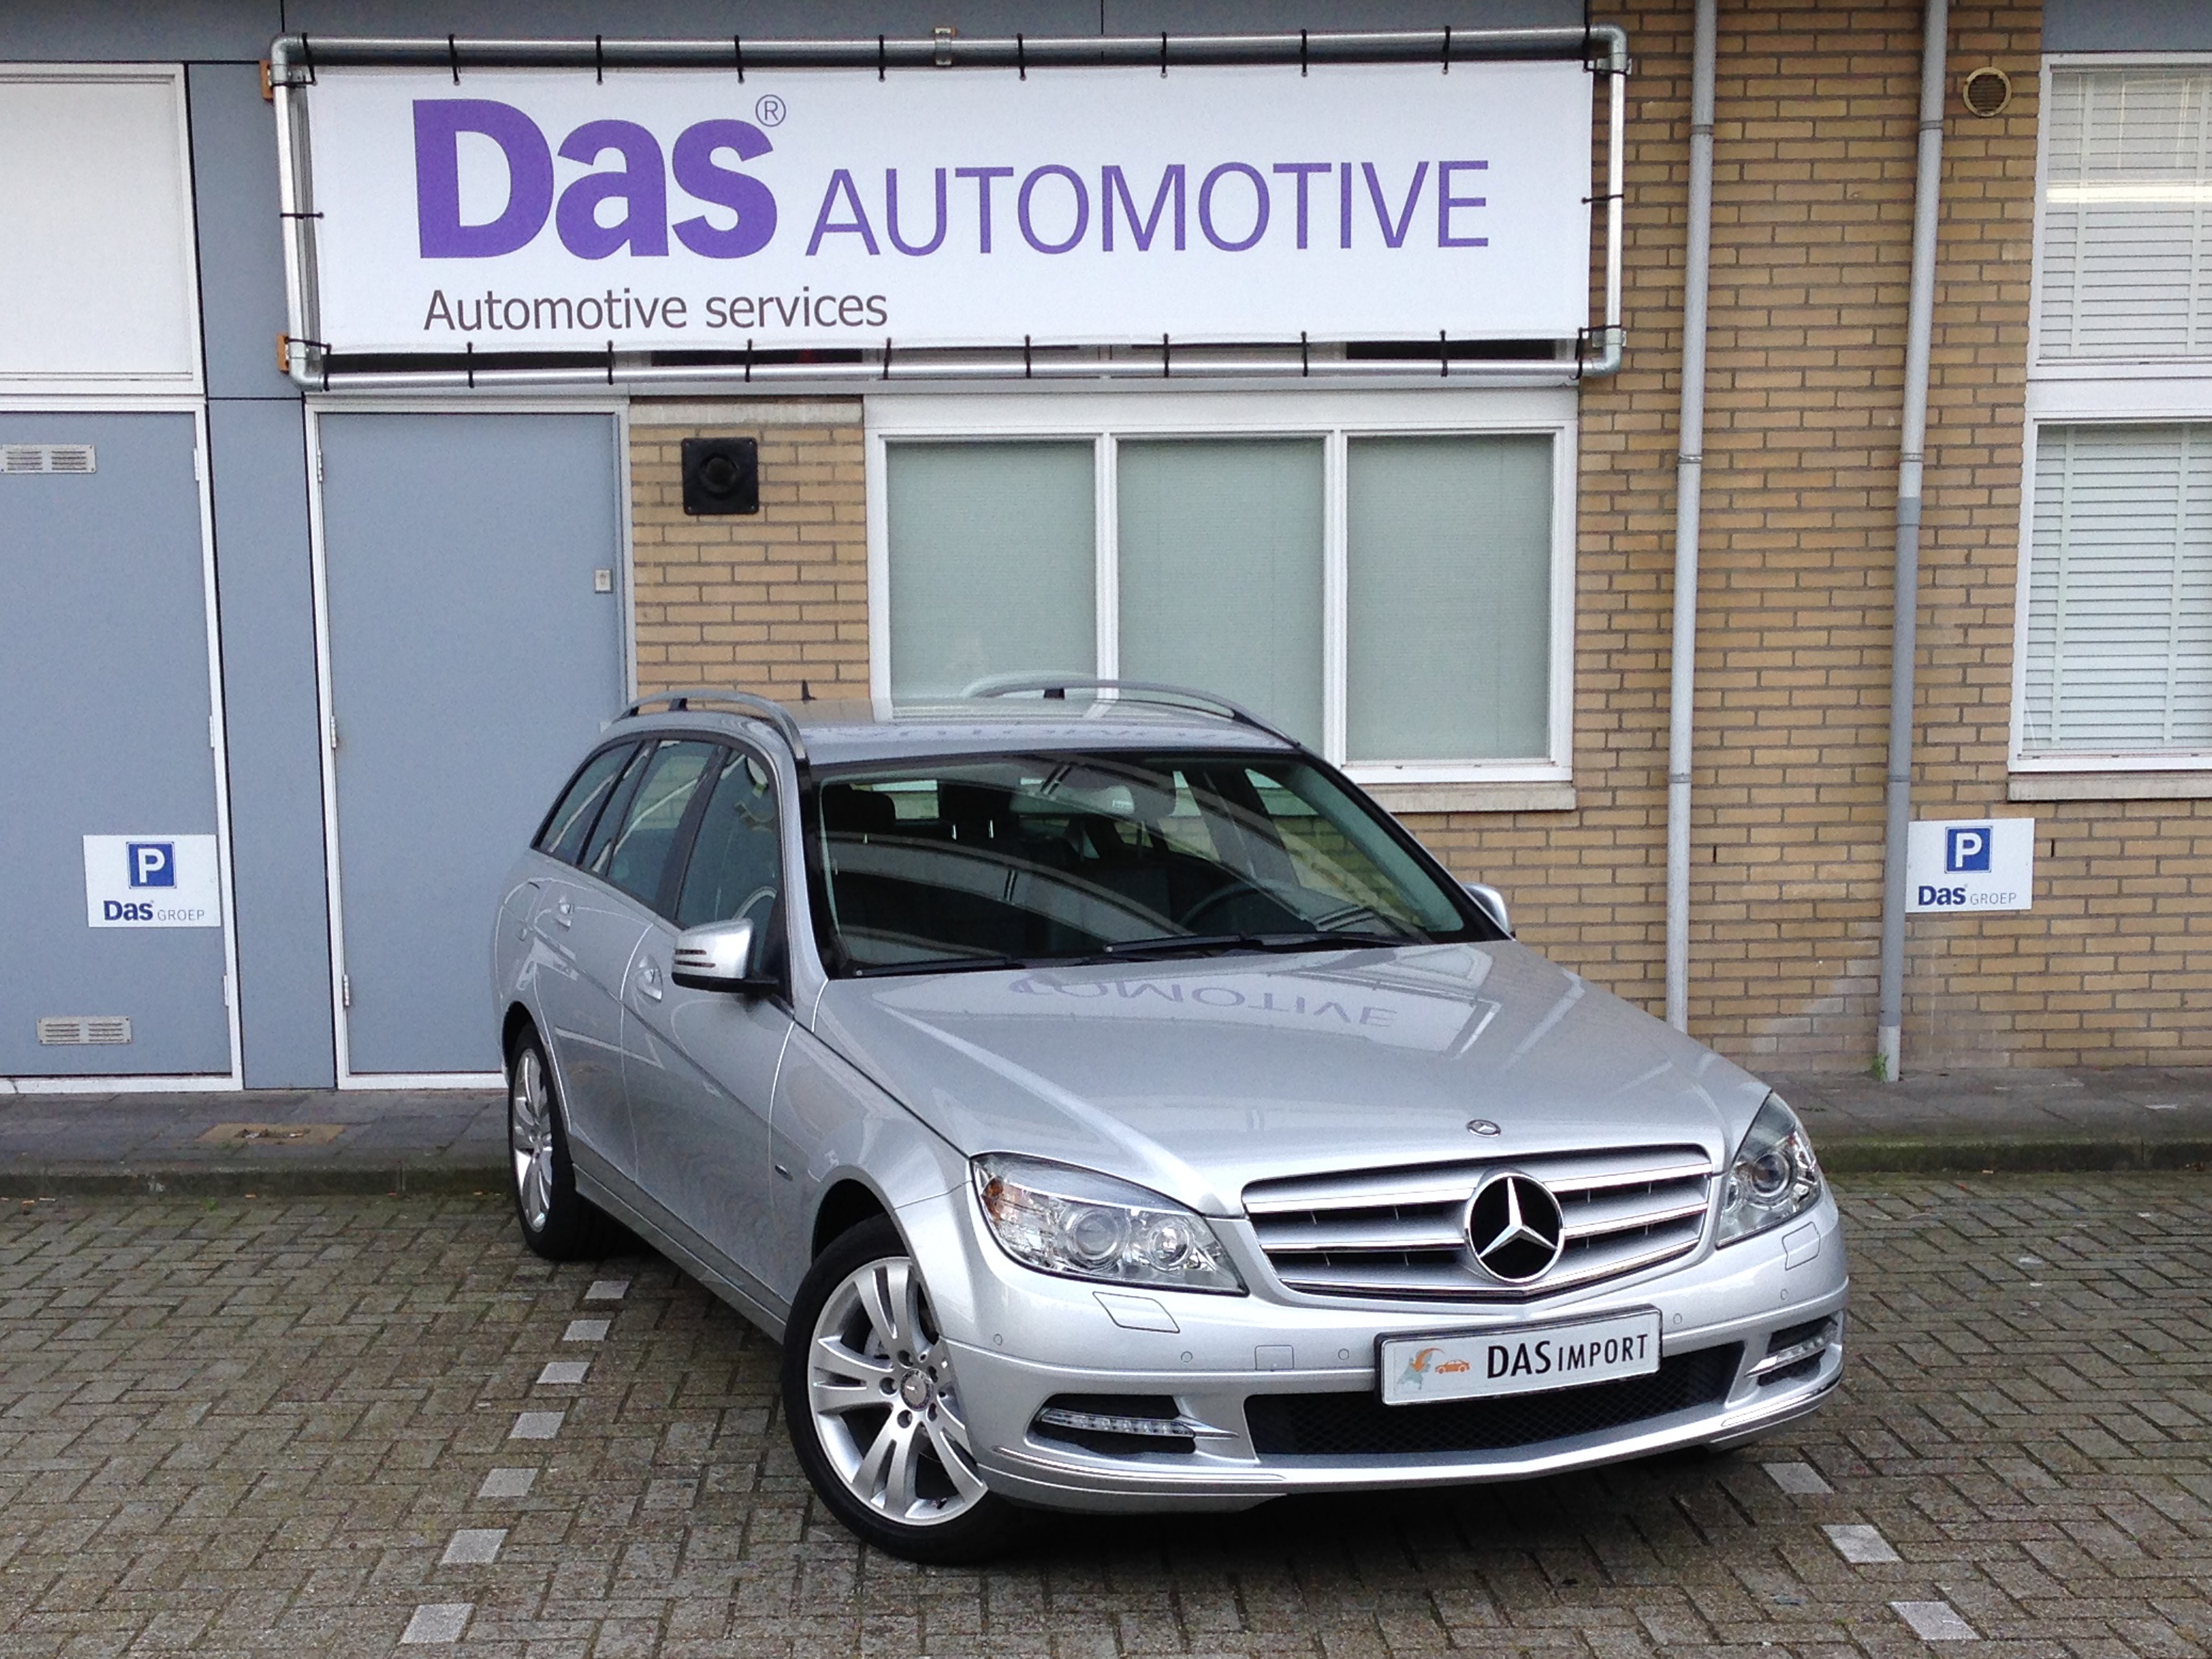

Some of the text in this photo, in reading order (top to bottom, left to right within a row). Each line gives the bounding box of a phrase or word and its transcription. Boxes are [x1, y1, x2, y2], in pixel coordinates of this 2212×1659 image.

[805, 160, 1489, 257] AUTOMOTIVE
[423, 286, 888, 331] Automotive services
[137, 848, 166, 884] P
[1955, 832, 1983, 868] P
[157, 909, 205, 921] GROEP
[1970, 892, 2017, 905] GROEP
[1487, 1334, 1648, 1379] DAS IMPORT
